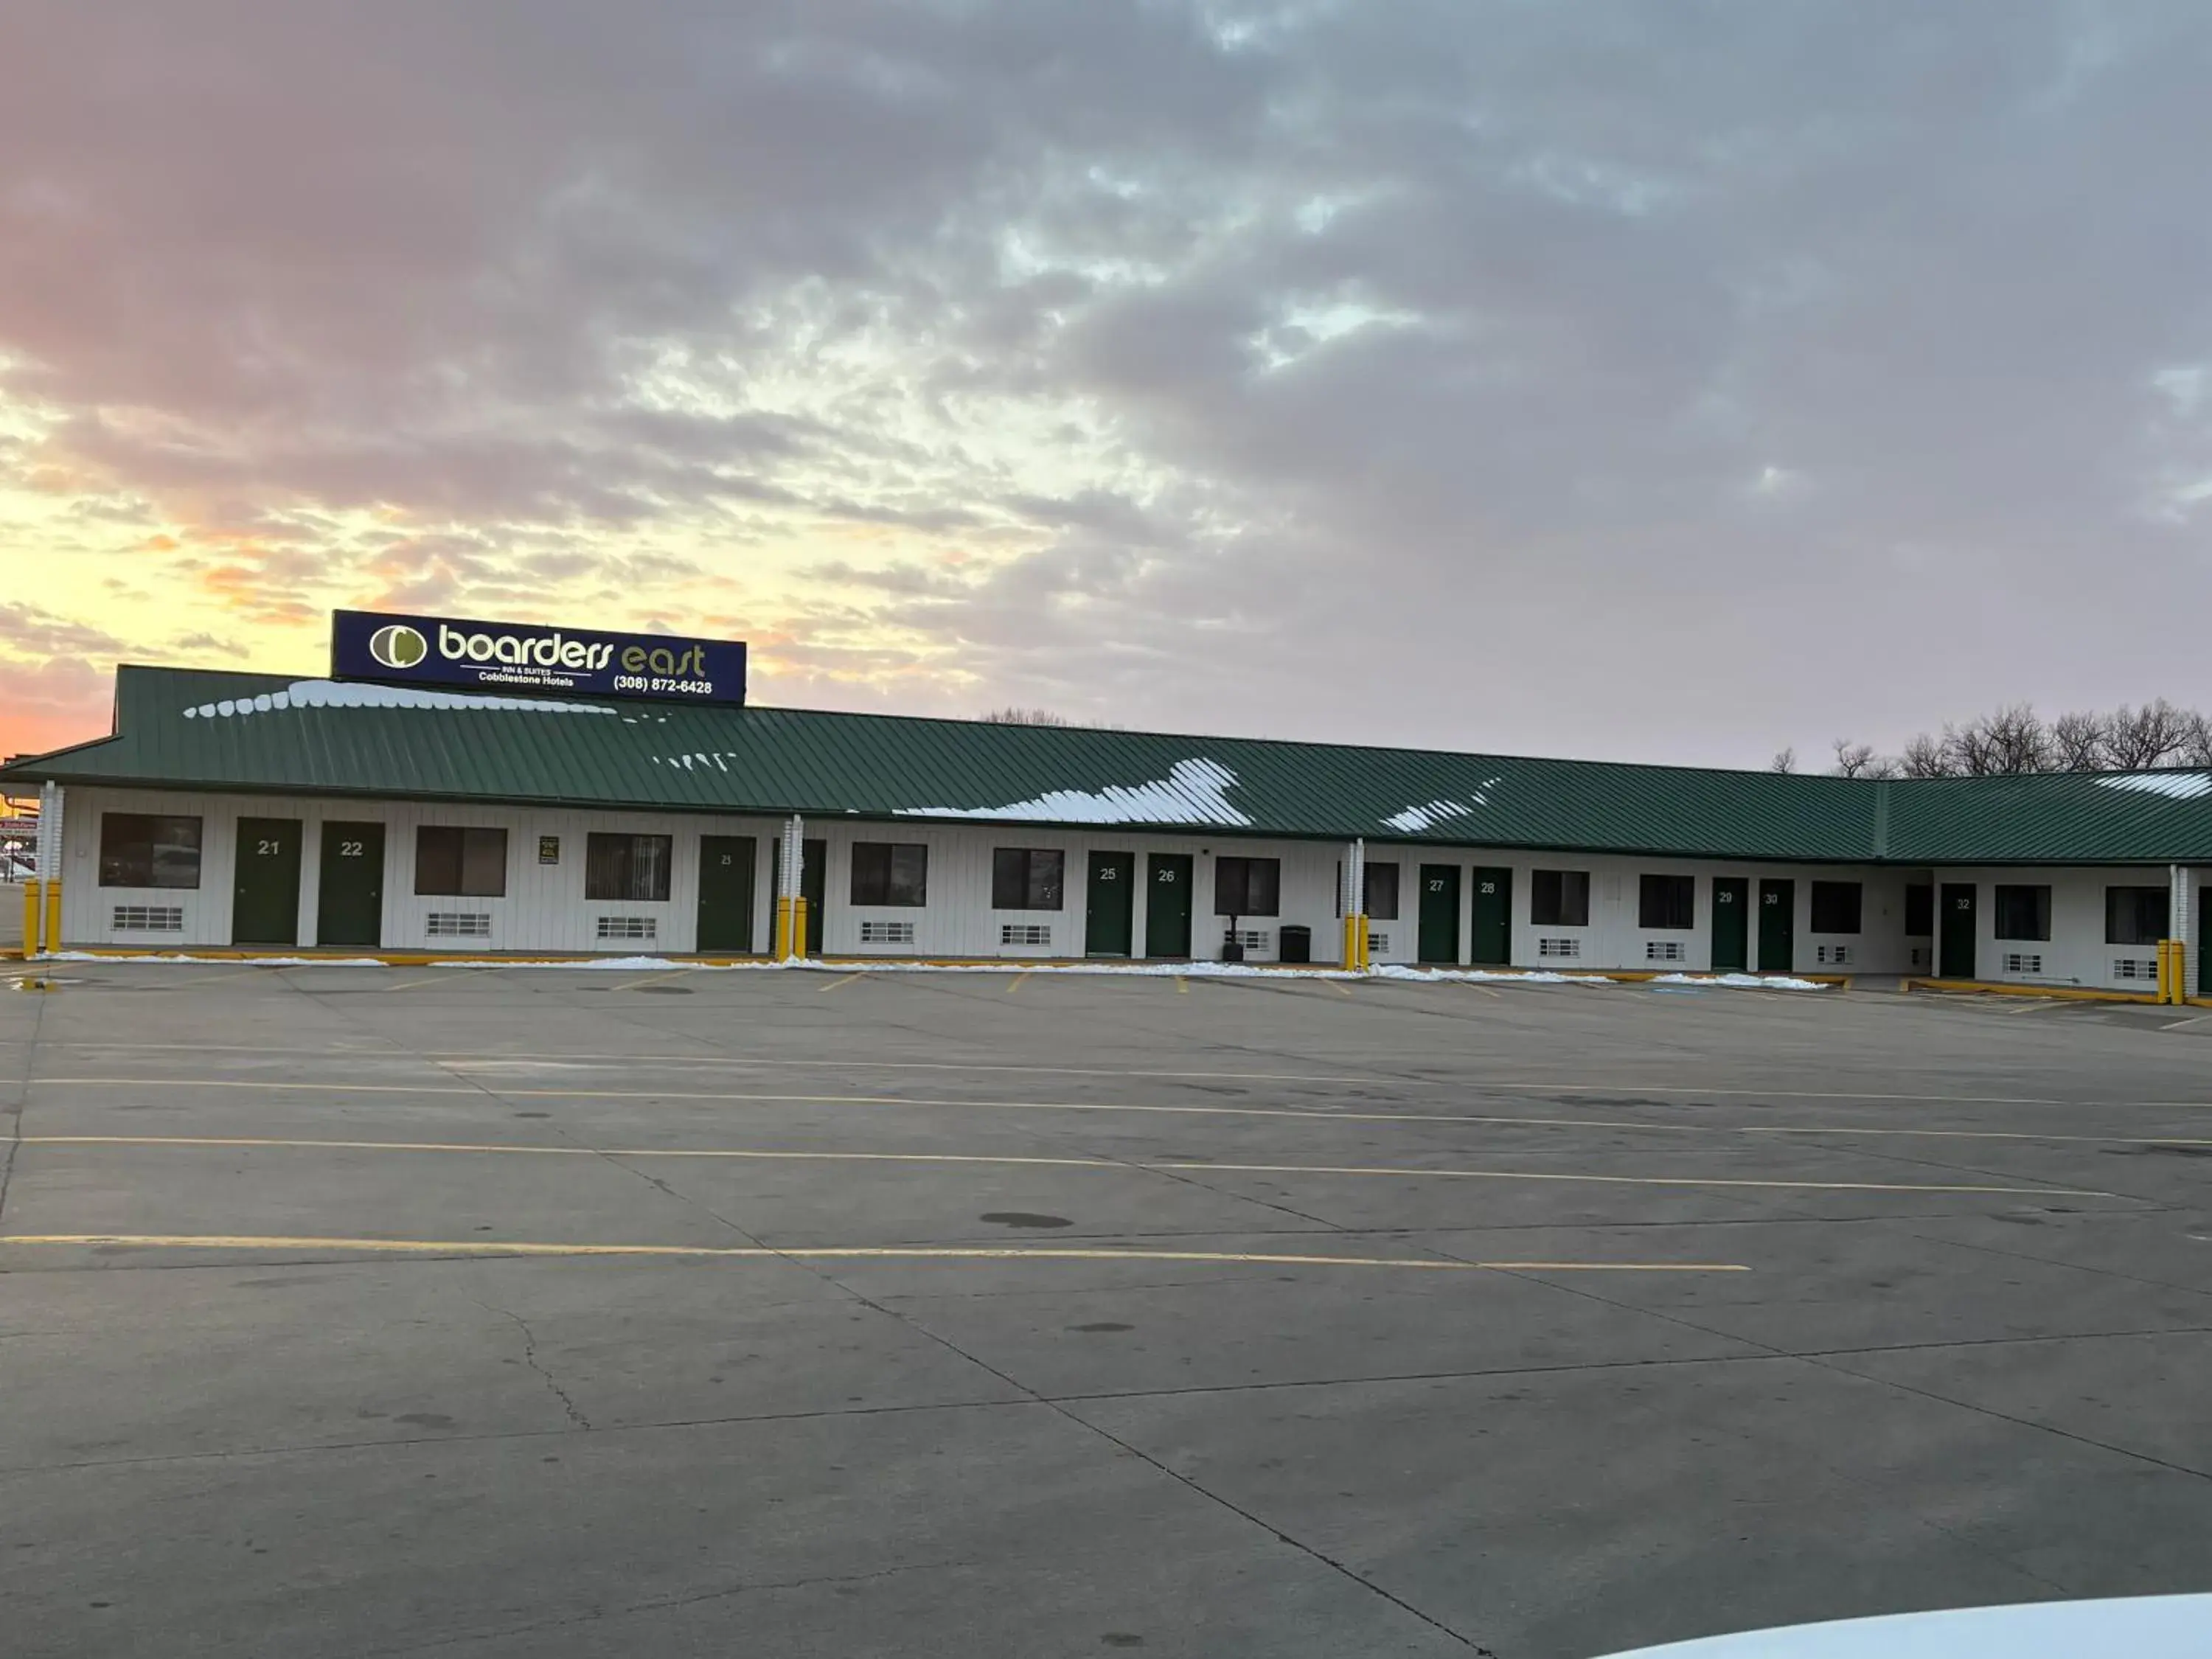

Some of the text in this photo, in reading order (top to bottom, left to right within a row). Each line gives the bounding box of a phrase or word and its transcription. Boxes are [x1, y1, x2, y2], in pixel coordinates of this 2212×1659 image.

[439, 625, 705, 677] boarders east
[524, 667, 551, 675] SUITES
[479, 671, 573, 686] Cobblestone Hotels
[613, 675, 712, 694] (308) 872-6428
[258, 840, 279, 855] 21
[341, 841, 363, 856] 22
[1100, 868, 1116, 880] 25
[1158, 869, 1175, 882] 26
[1430, 880, 1444, 891] 27
[1481, 883, 1495, 894] 28
[1958, 899, 1969, 909] 32
